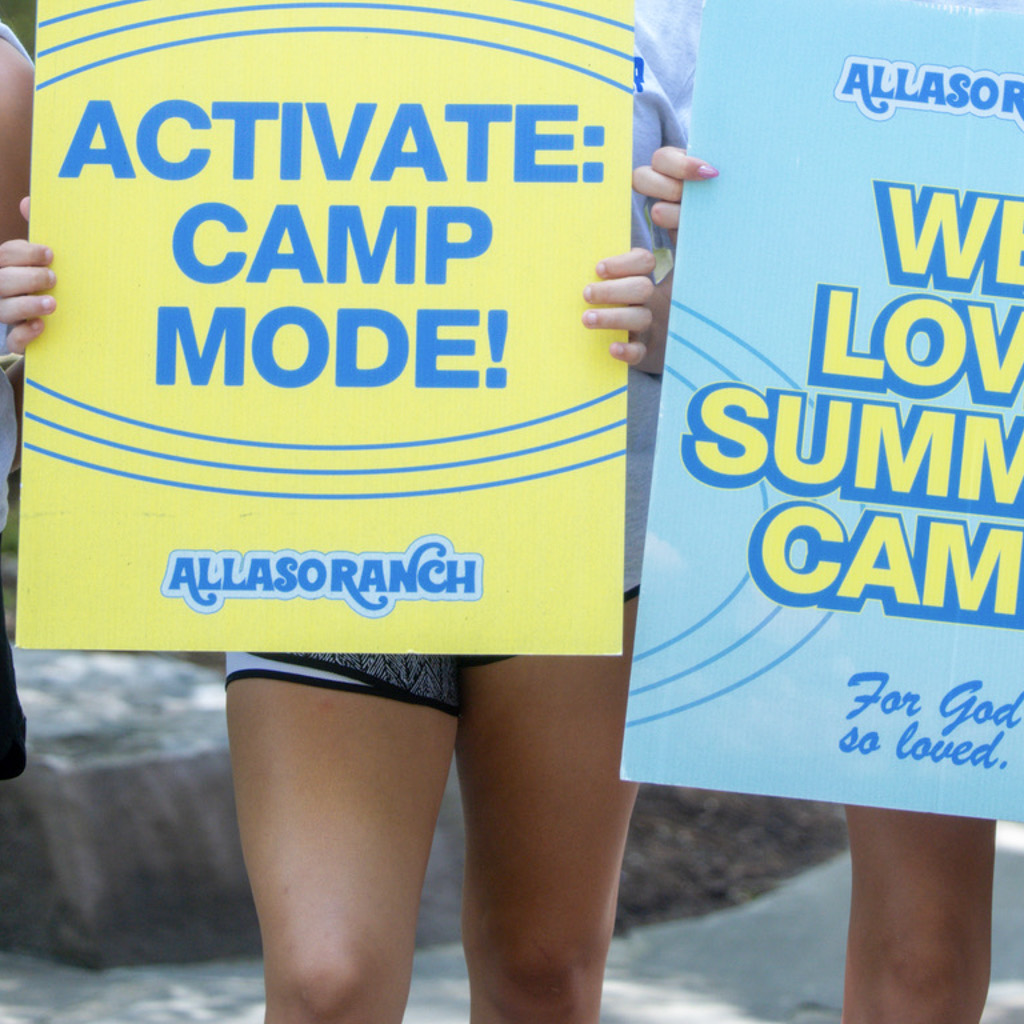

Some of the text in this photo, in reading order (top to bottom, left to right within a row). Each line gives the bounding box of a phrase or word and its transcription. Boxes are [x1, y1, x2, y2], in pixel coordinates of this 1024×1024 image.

[58, 99, 604, 183] ACTIVATE:
[172, 202, 494, 285] CAMP
[155, 306, 509, 388] MODE!
[847, 671, 922, 720] For
[838, 720, 1008, 770] so loved.
